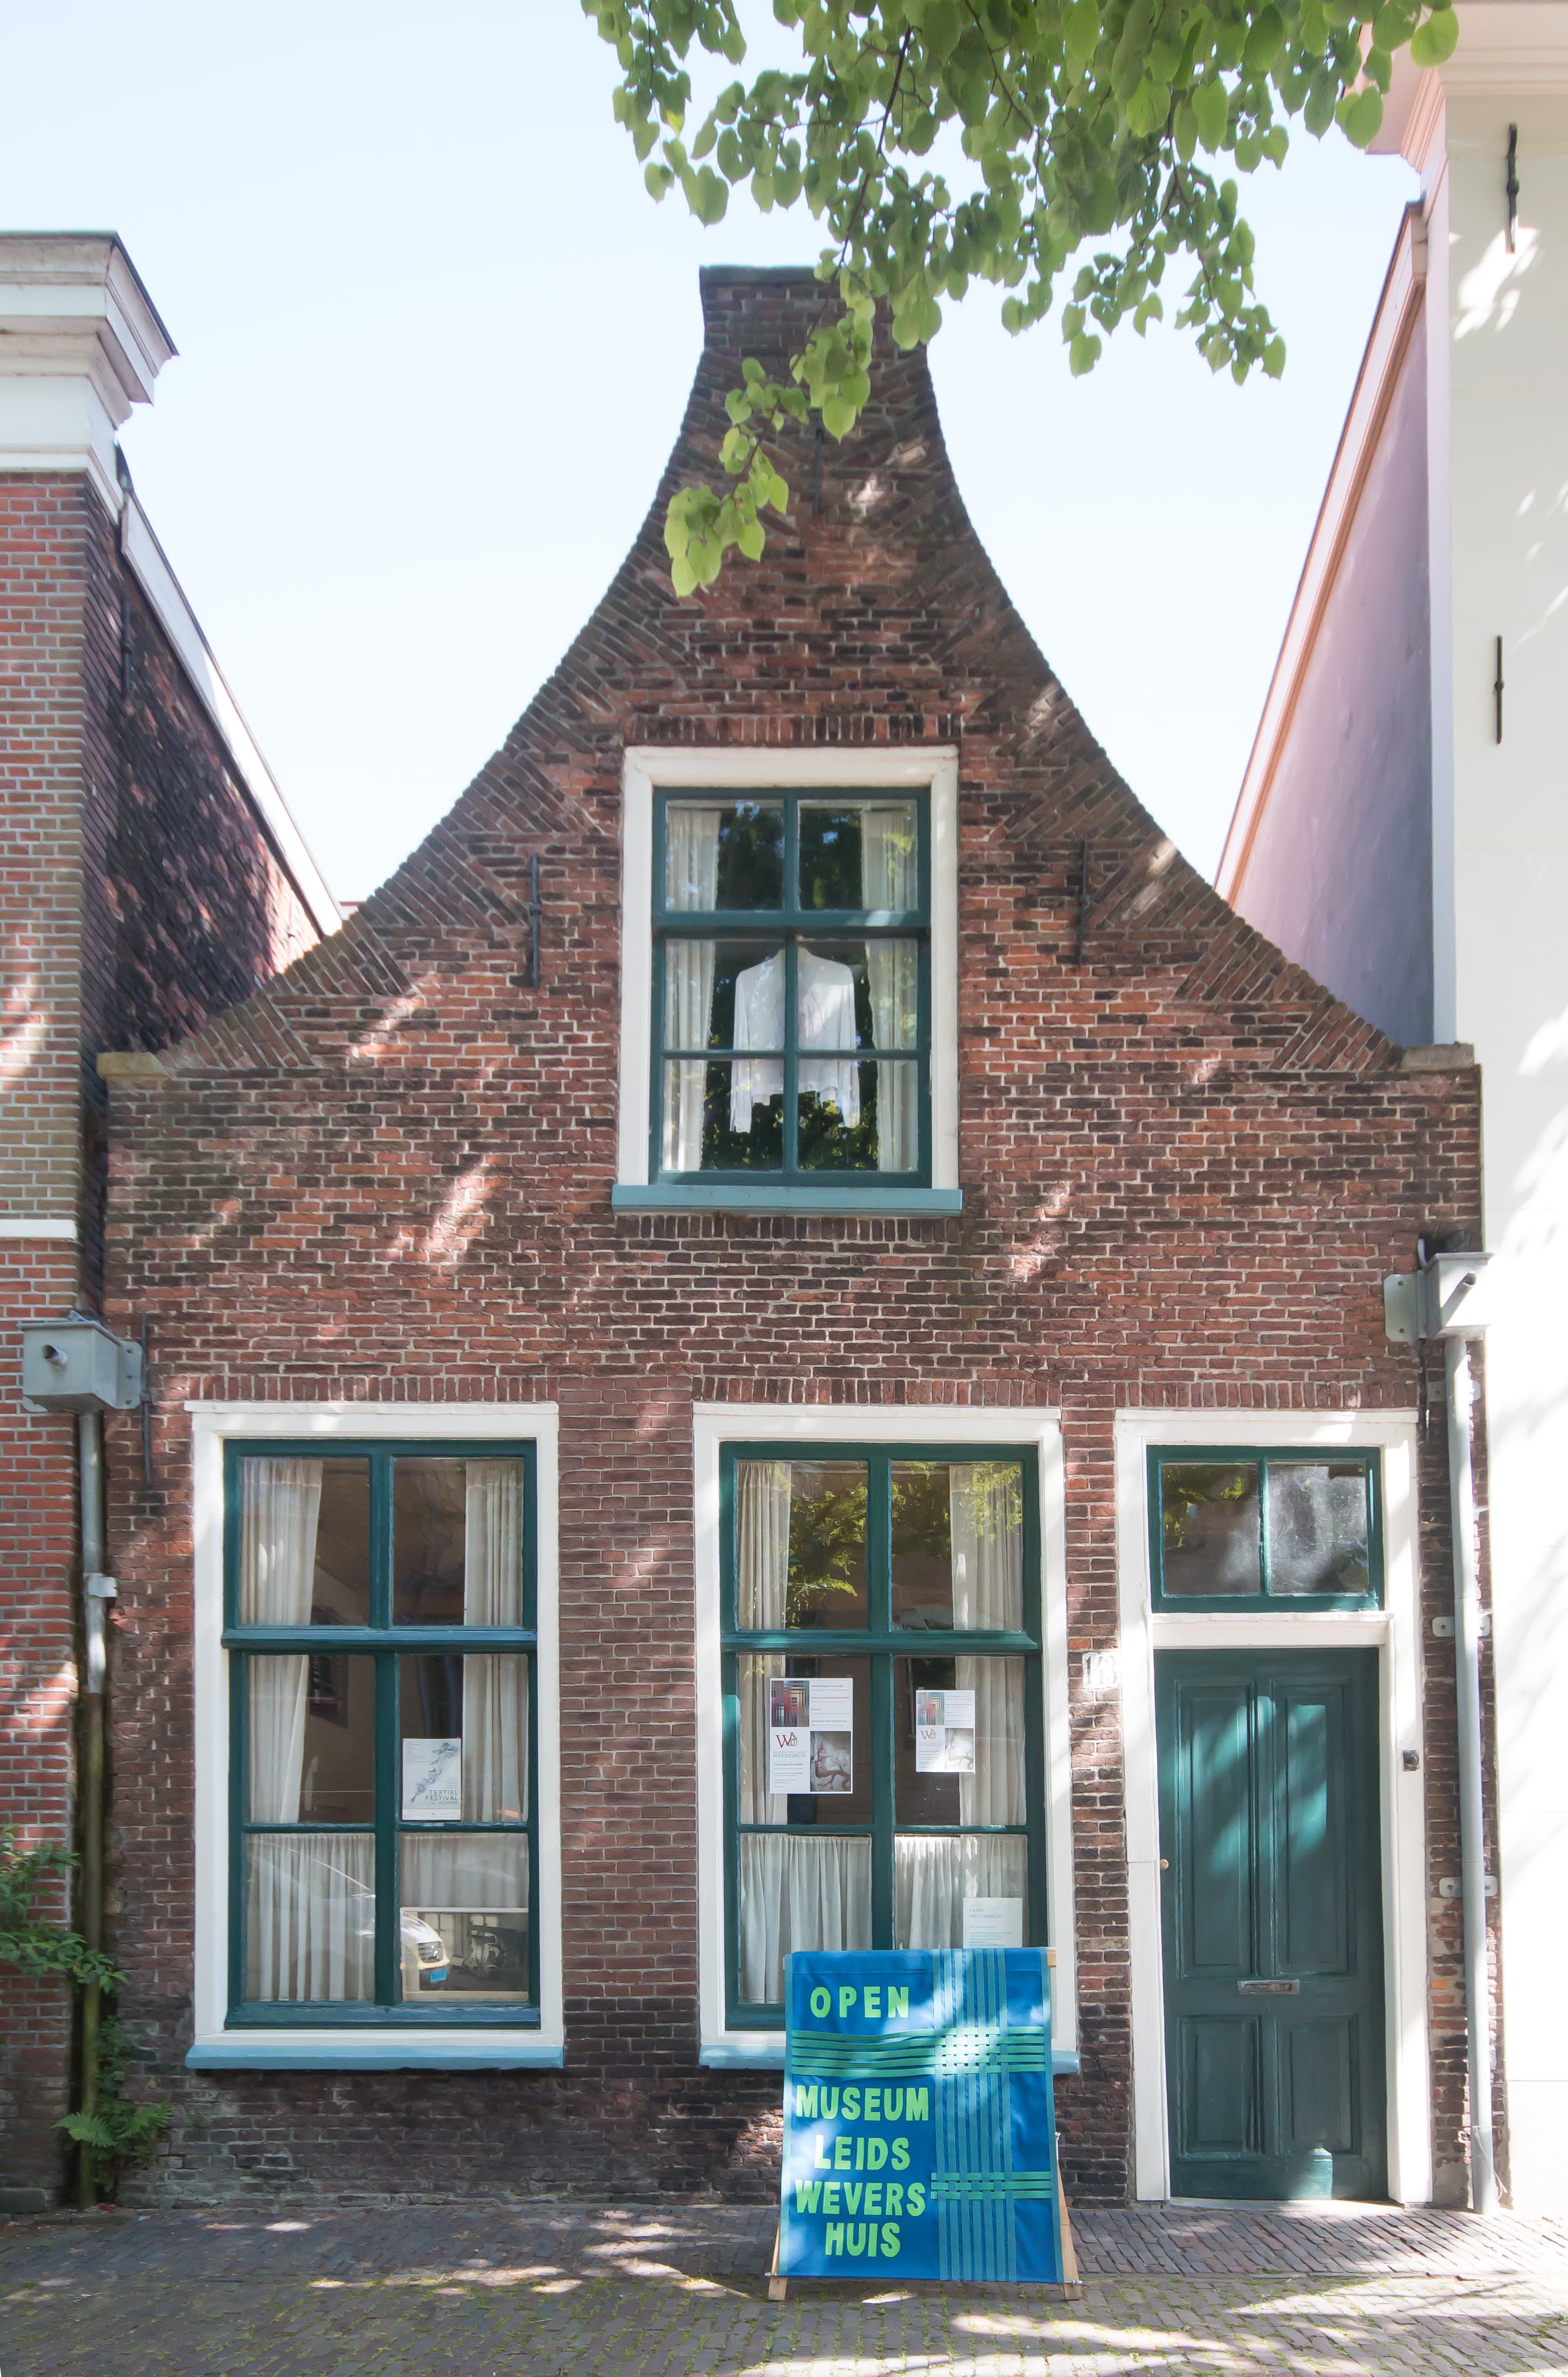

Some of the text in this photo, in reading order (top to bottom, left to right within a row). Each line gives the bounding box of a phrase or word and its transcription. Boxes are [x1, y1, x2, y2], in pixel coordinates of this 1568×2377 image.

[810, 1986, 909, 2018] OPEN
[795, 2085, 929, 2121] MUSEUM
[814, 2134, 911, 2171] LEIDS
[794, 2179, 926, 2217] WEVERS
[824, 2222, 901, 2257] HUIS
